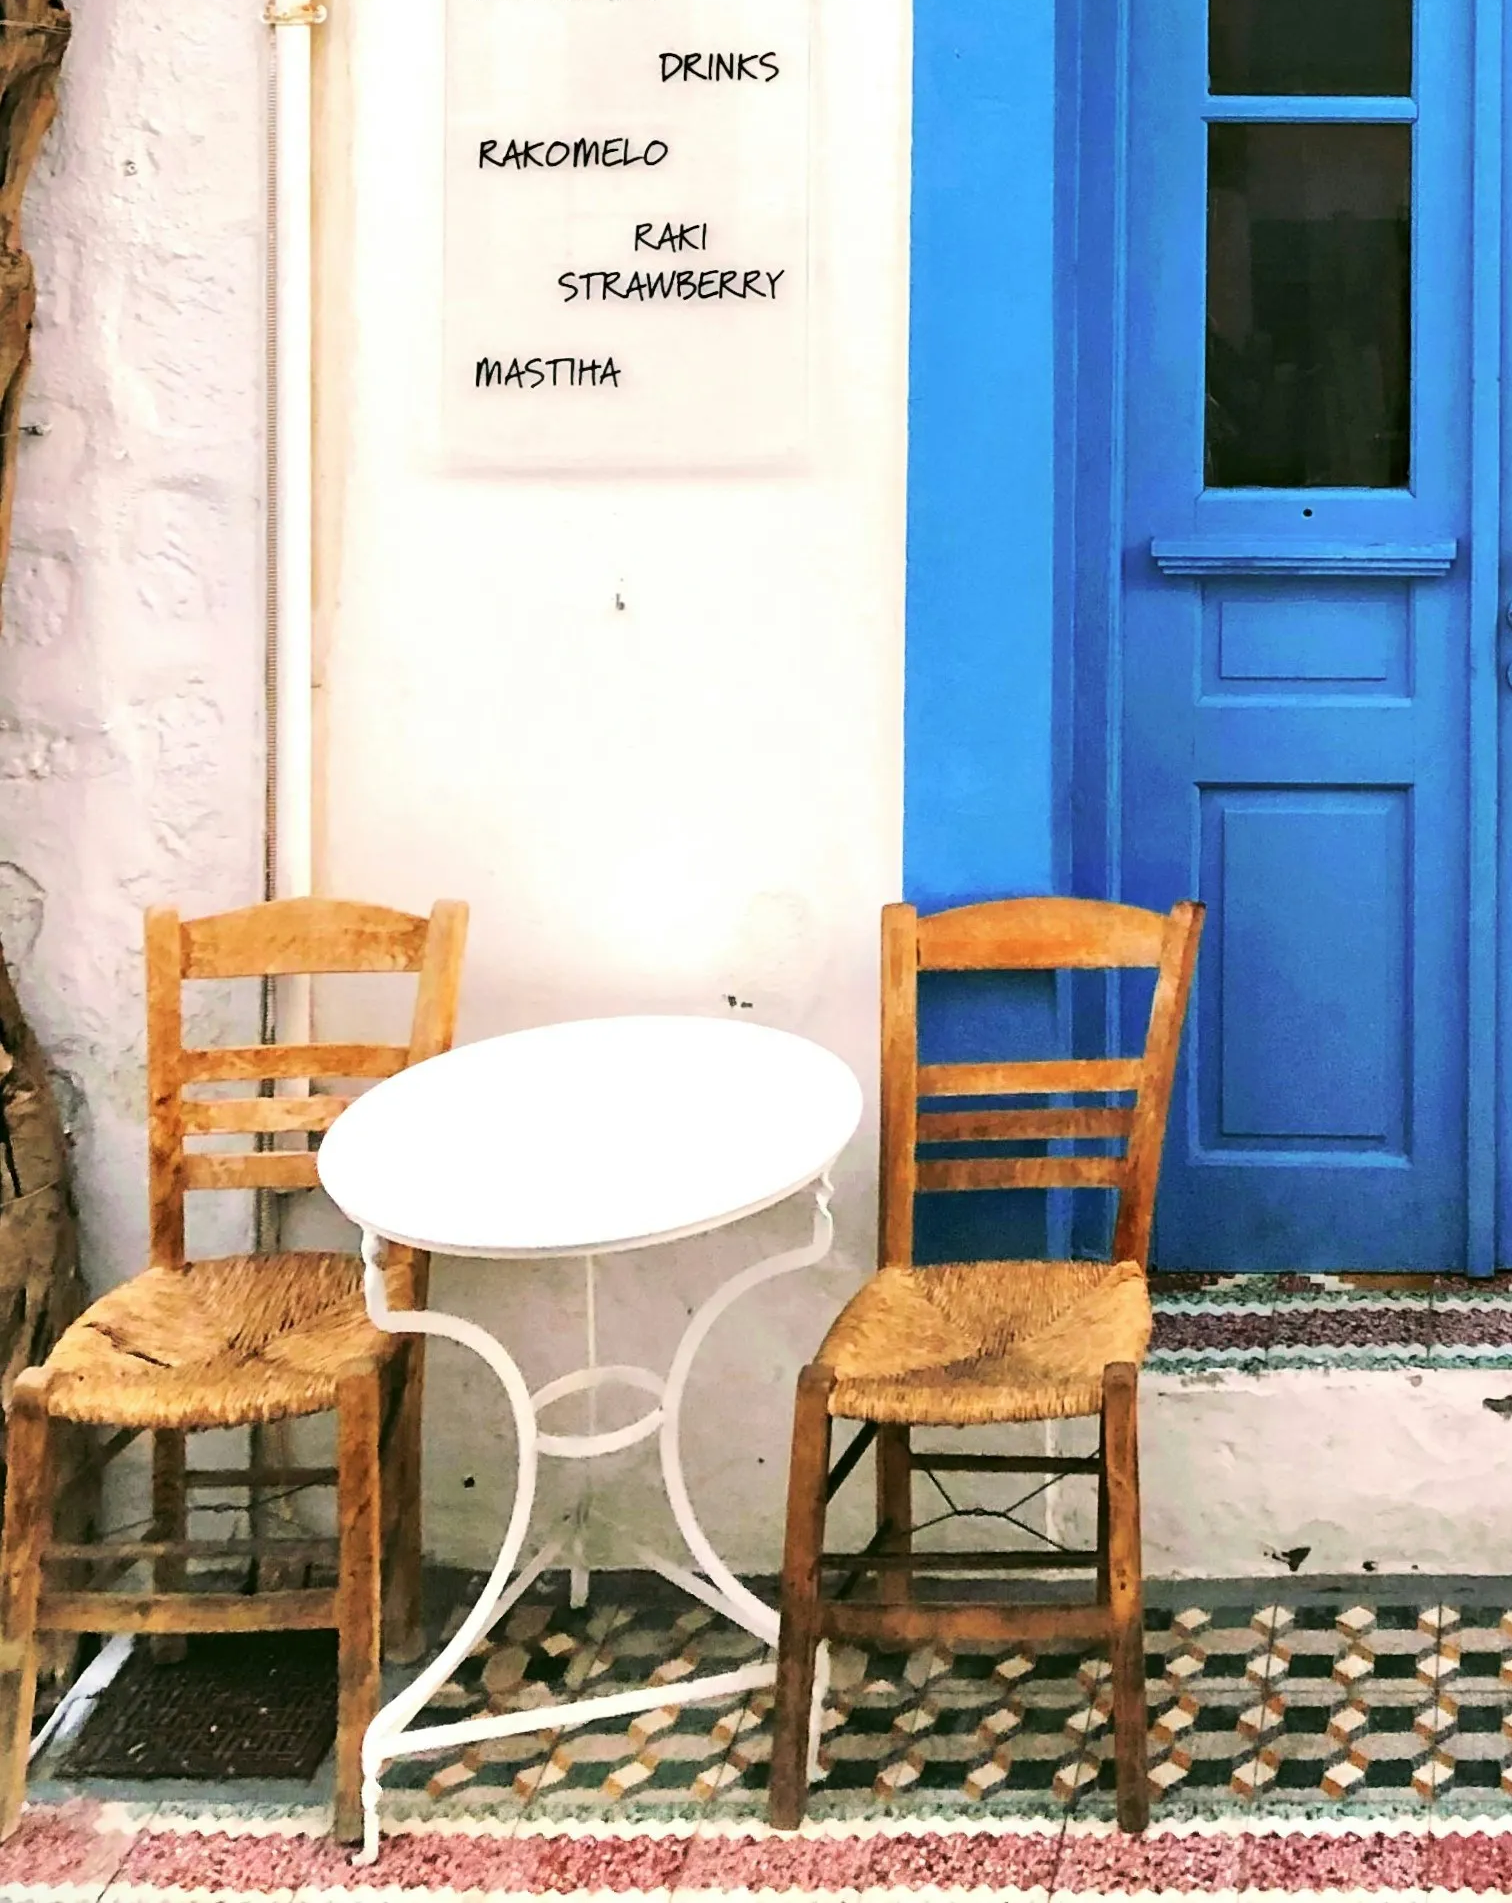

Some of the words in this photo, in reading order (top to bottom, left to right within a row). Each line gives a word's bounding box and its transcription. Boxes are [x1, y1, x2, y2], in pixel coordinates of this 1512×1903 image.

[658, 51, 780, 83] DRINKS
[478, 137, 669, 170] RAKOMELO
[633, 221, 708, 252] RAKI
[557, 269, 785, 302] STRAWBERRY
[474, 355, 622, 389] MASTIHA
